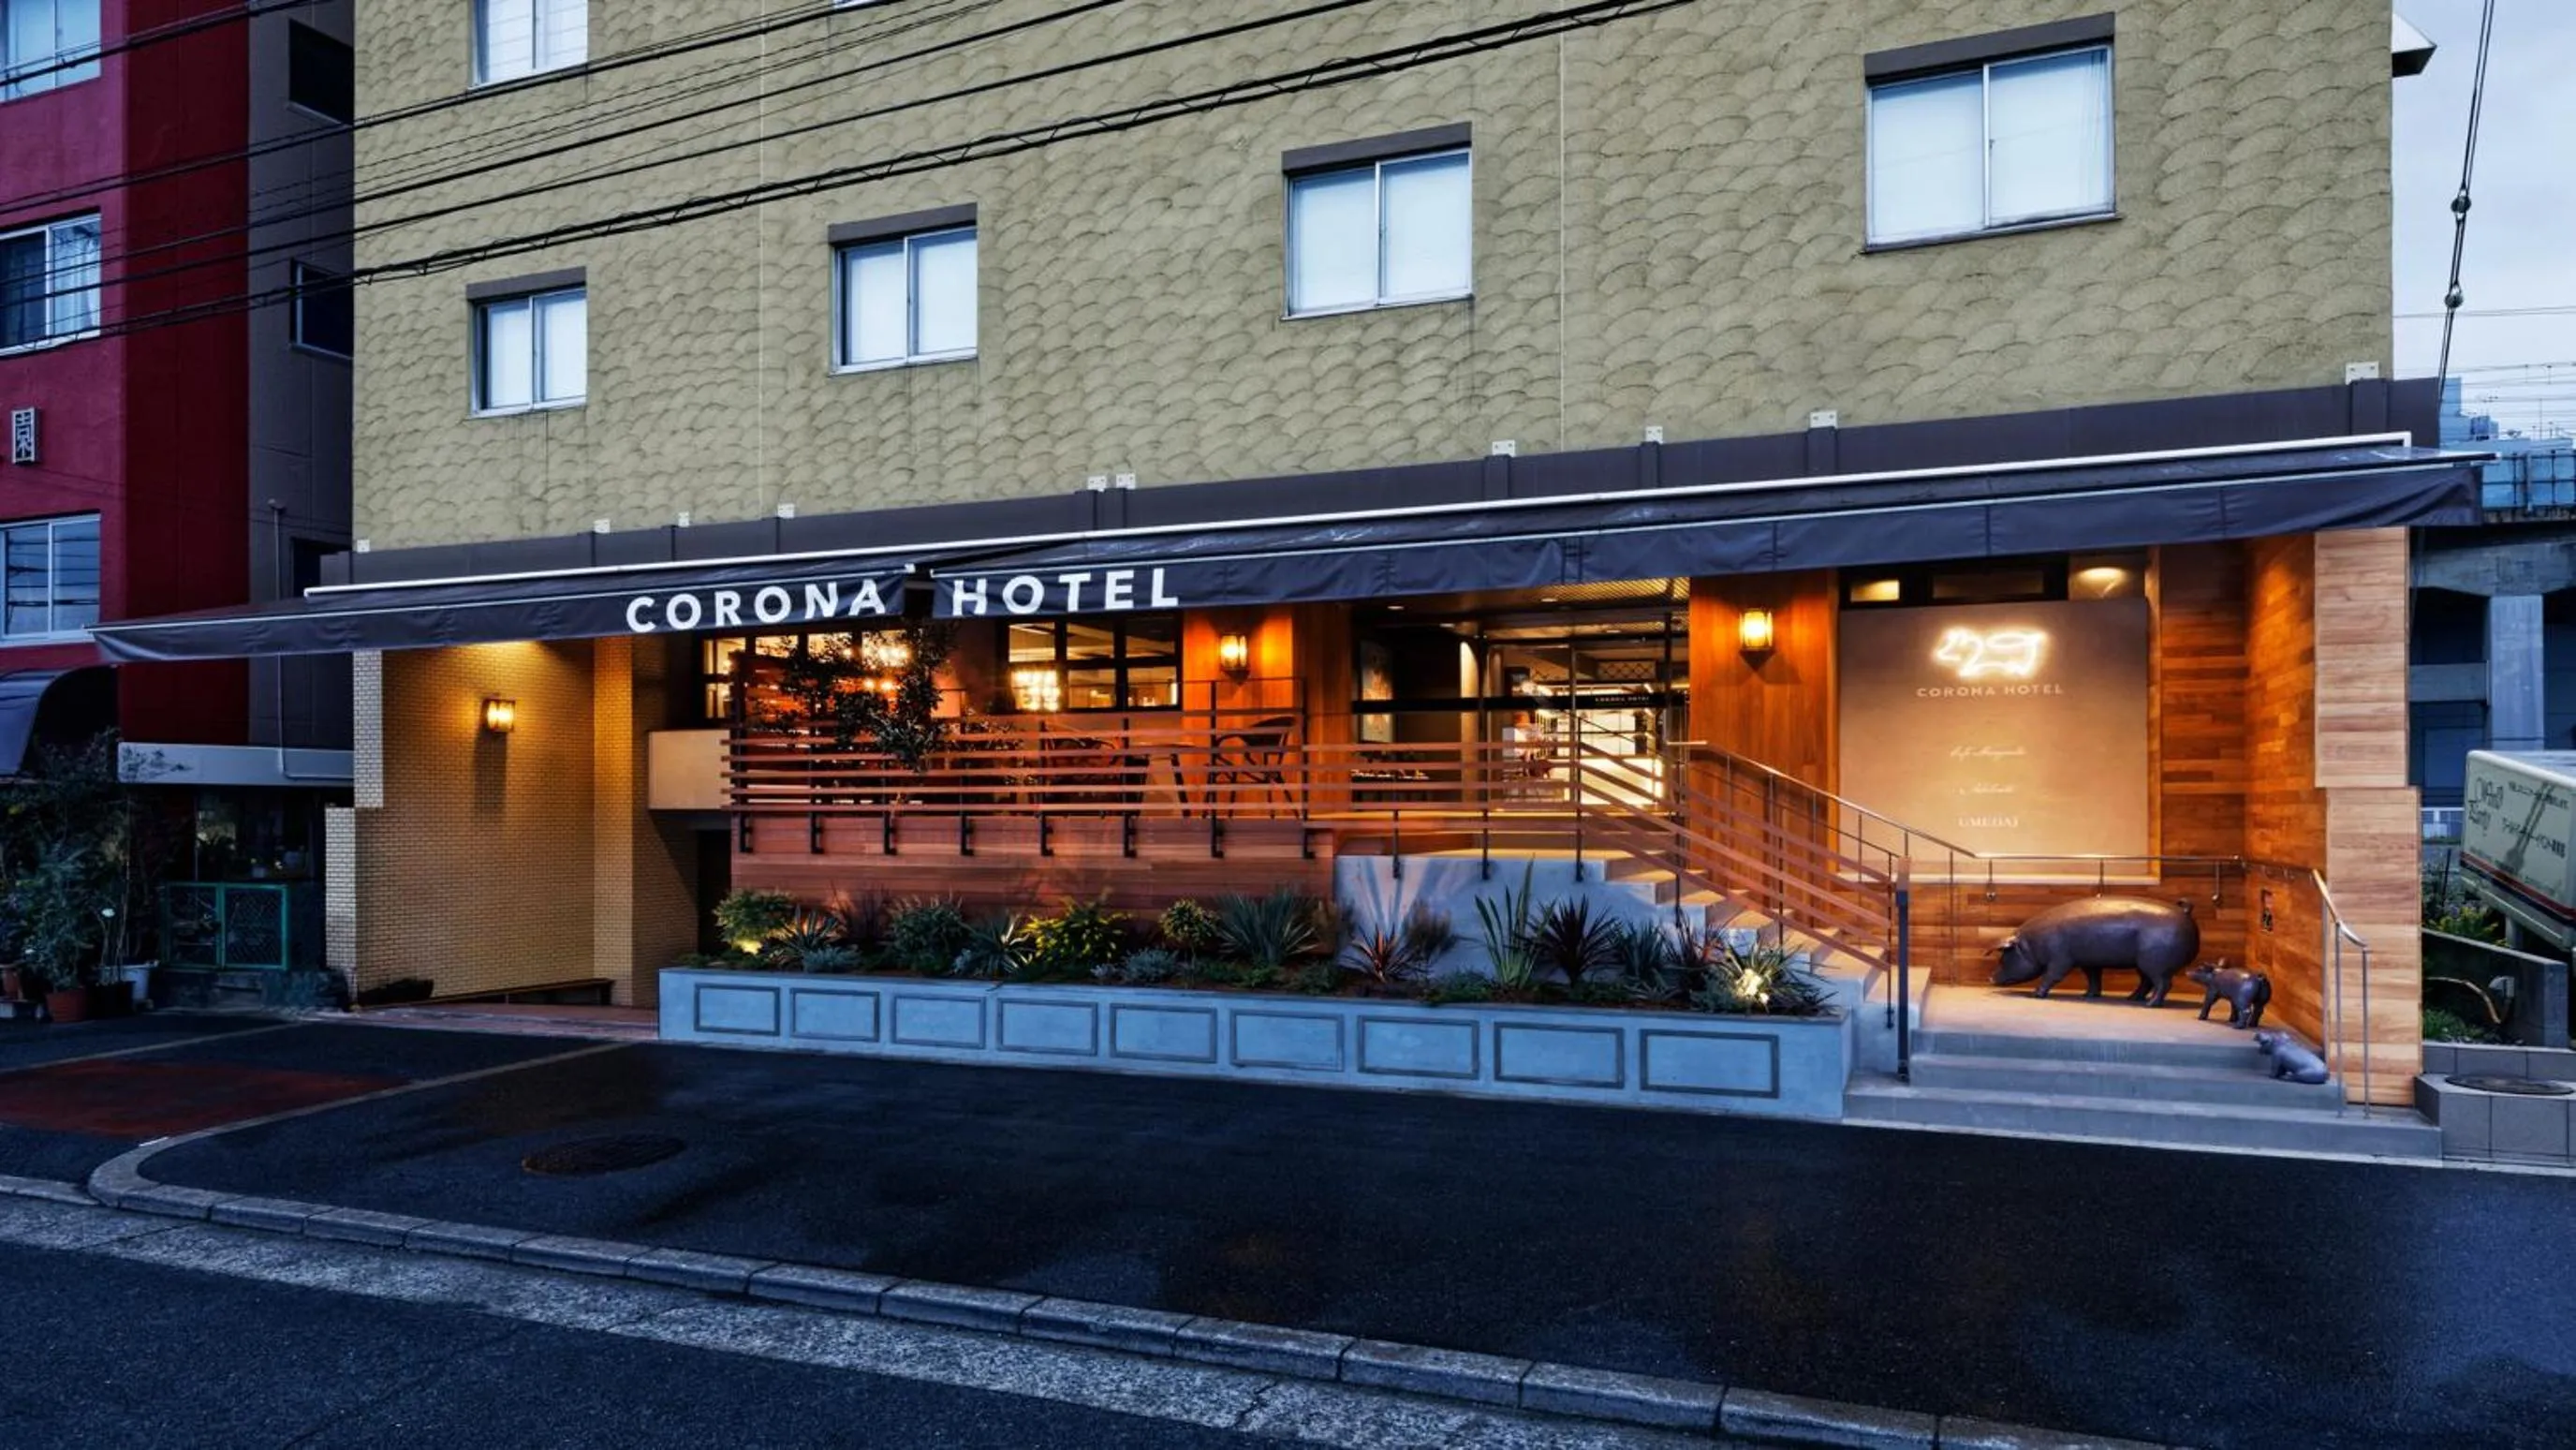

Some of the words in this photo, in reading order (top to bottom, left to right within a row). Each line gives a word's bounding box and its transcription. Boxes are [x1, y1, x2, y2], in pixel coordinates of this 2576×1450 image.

[626, 578, 888, 634] CORONA
[951, 567, 1180, 617] HOTEL
[1916, 686, 1996, 698] CORONA
[2004, 683, 2064, 696] HOTEL
